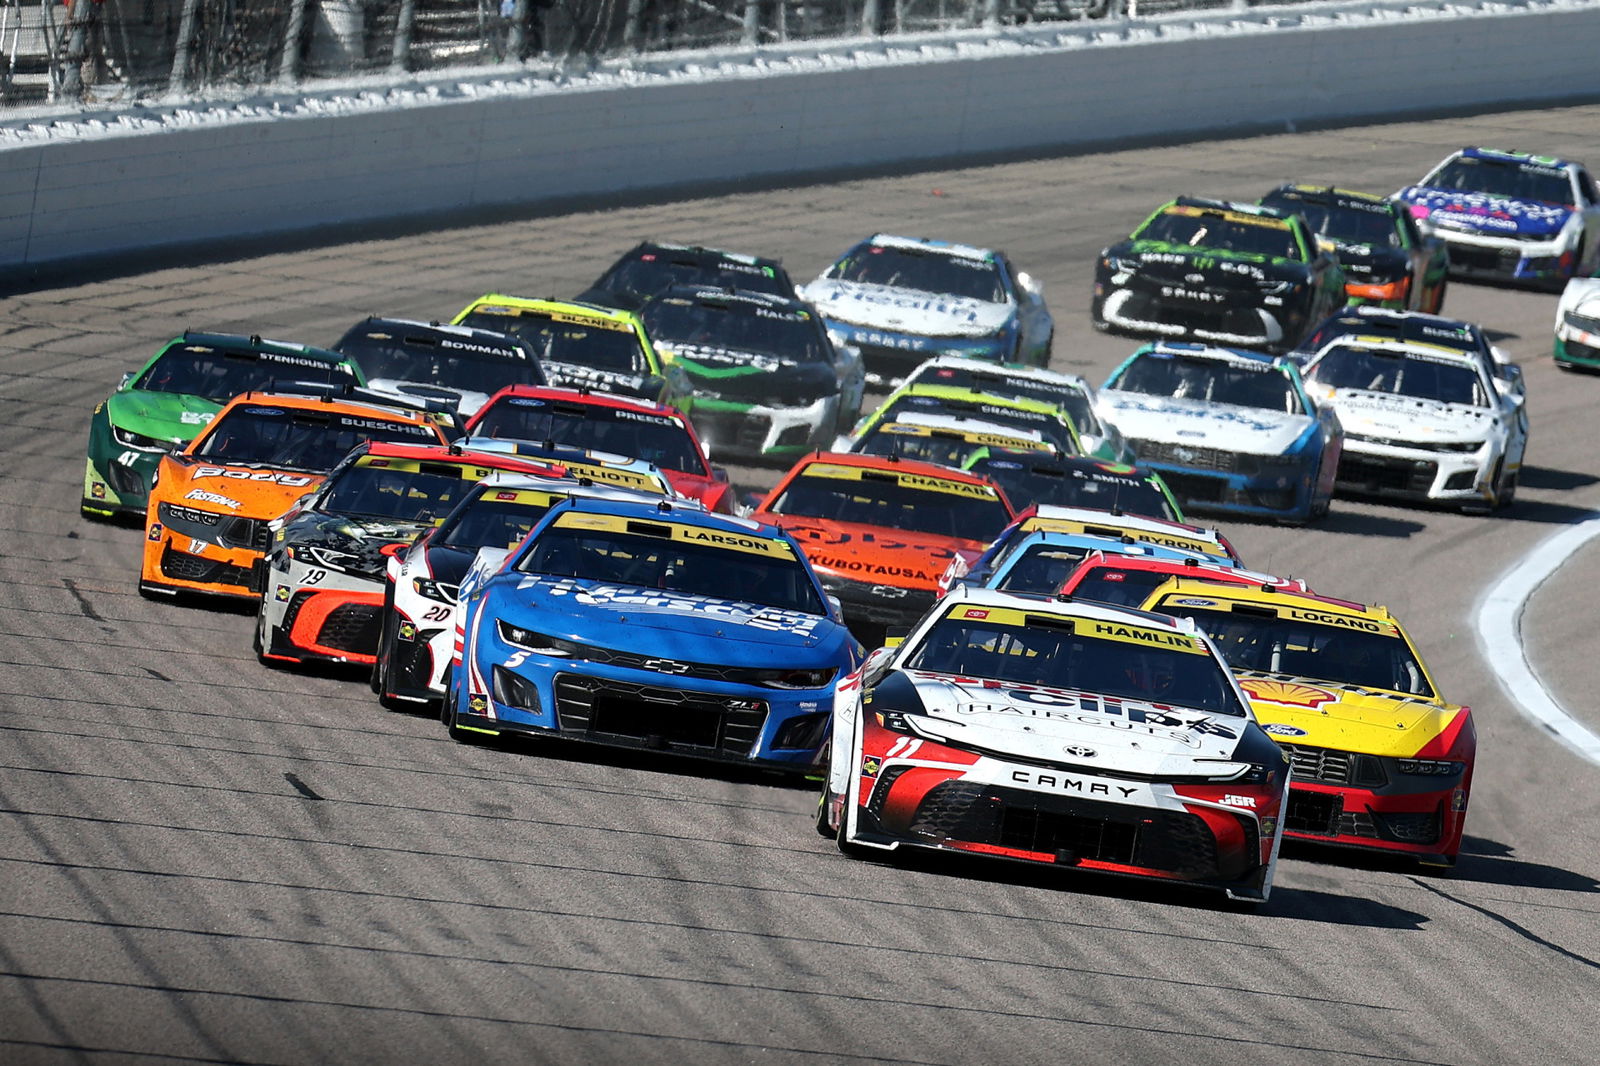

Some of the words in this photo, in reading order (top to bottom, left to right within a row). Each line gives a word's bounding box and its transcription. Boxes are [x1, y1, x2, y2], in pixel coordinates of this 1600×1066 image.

[441, 340, 514, 358] BOWMAN
[260, 352, 331, 370] STENHOUSE
[616, 410, 672, 426] PREECE
[117, 450, 141, 467] 47
[568, 466, 645, 486] ELLIOTT
[188, 539, 209, 554] 17
[683, 530, 769, 552] LARSON
[1139, 535, 1202, 552] BYRON
[297, 568, 328, 586] 19
[422, 606, 451, 622] 20
[1292, 610, 1380, 633] LOGANO
[1095, 624, 1193, 650] HAMLIN
[503, 650, 533, 668] 5
[968, 703, 1191, 744] HAIRCUTS
[1264, 724, 1302, 736] Ford
[886, 736, 925, 758] 11
[1011, 771, 1139, 799] CAMRY
[1218, 793, 1257, 808] JGR
